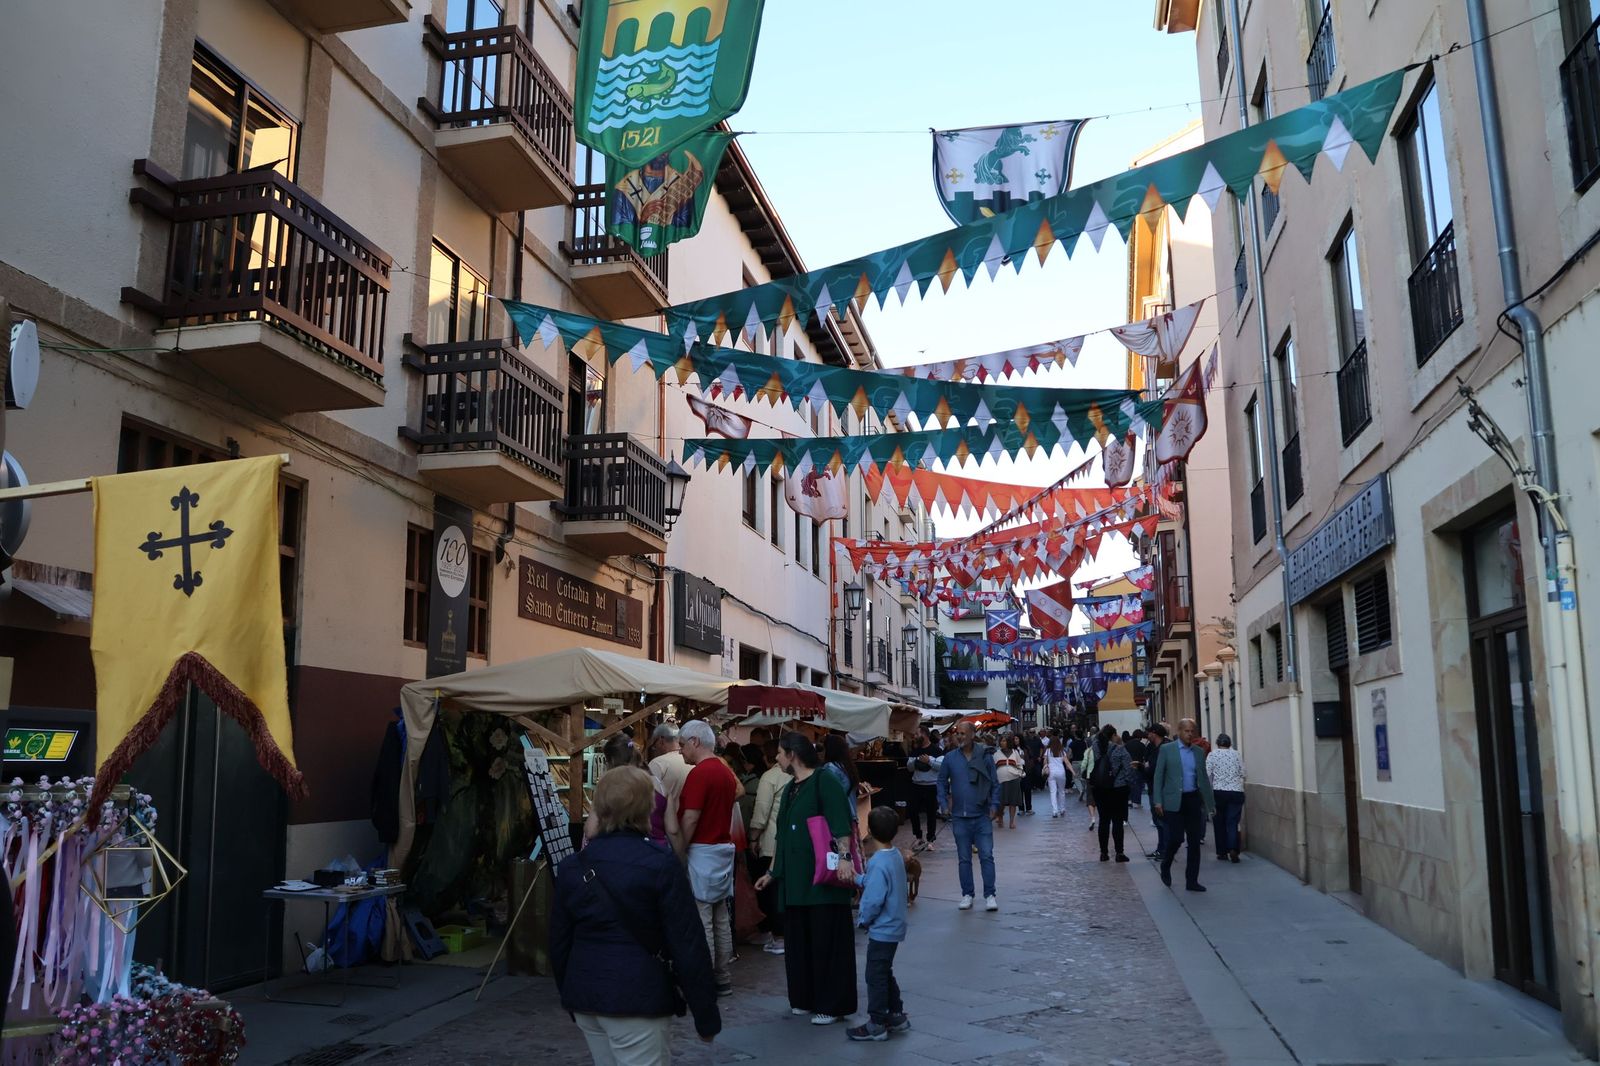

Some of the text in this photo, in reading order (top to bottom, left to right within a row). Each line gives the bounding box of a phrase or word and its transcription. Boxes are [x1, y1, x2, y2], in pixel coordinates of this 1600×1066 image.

[619, 126, 661, 152] 1521
[1344, 506, 1354, 533] DE
[1355, 491, 1372, 525] LOS
[440, 537, 467, 566] 100
[526, 563, 607, 611] Real Cofradia del
[686, 583, 695, 622] La
[525, 592, 552, 619] Santo
[555, 602, 589, 629] Entierro
